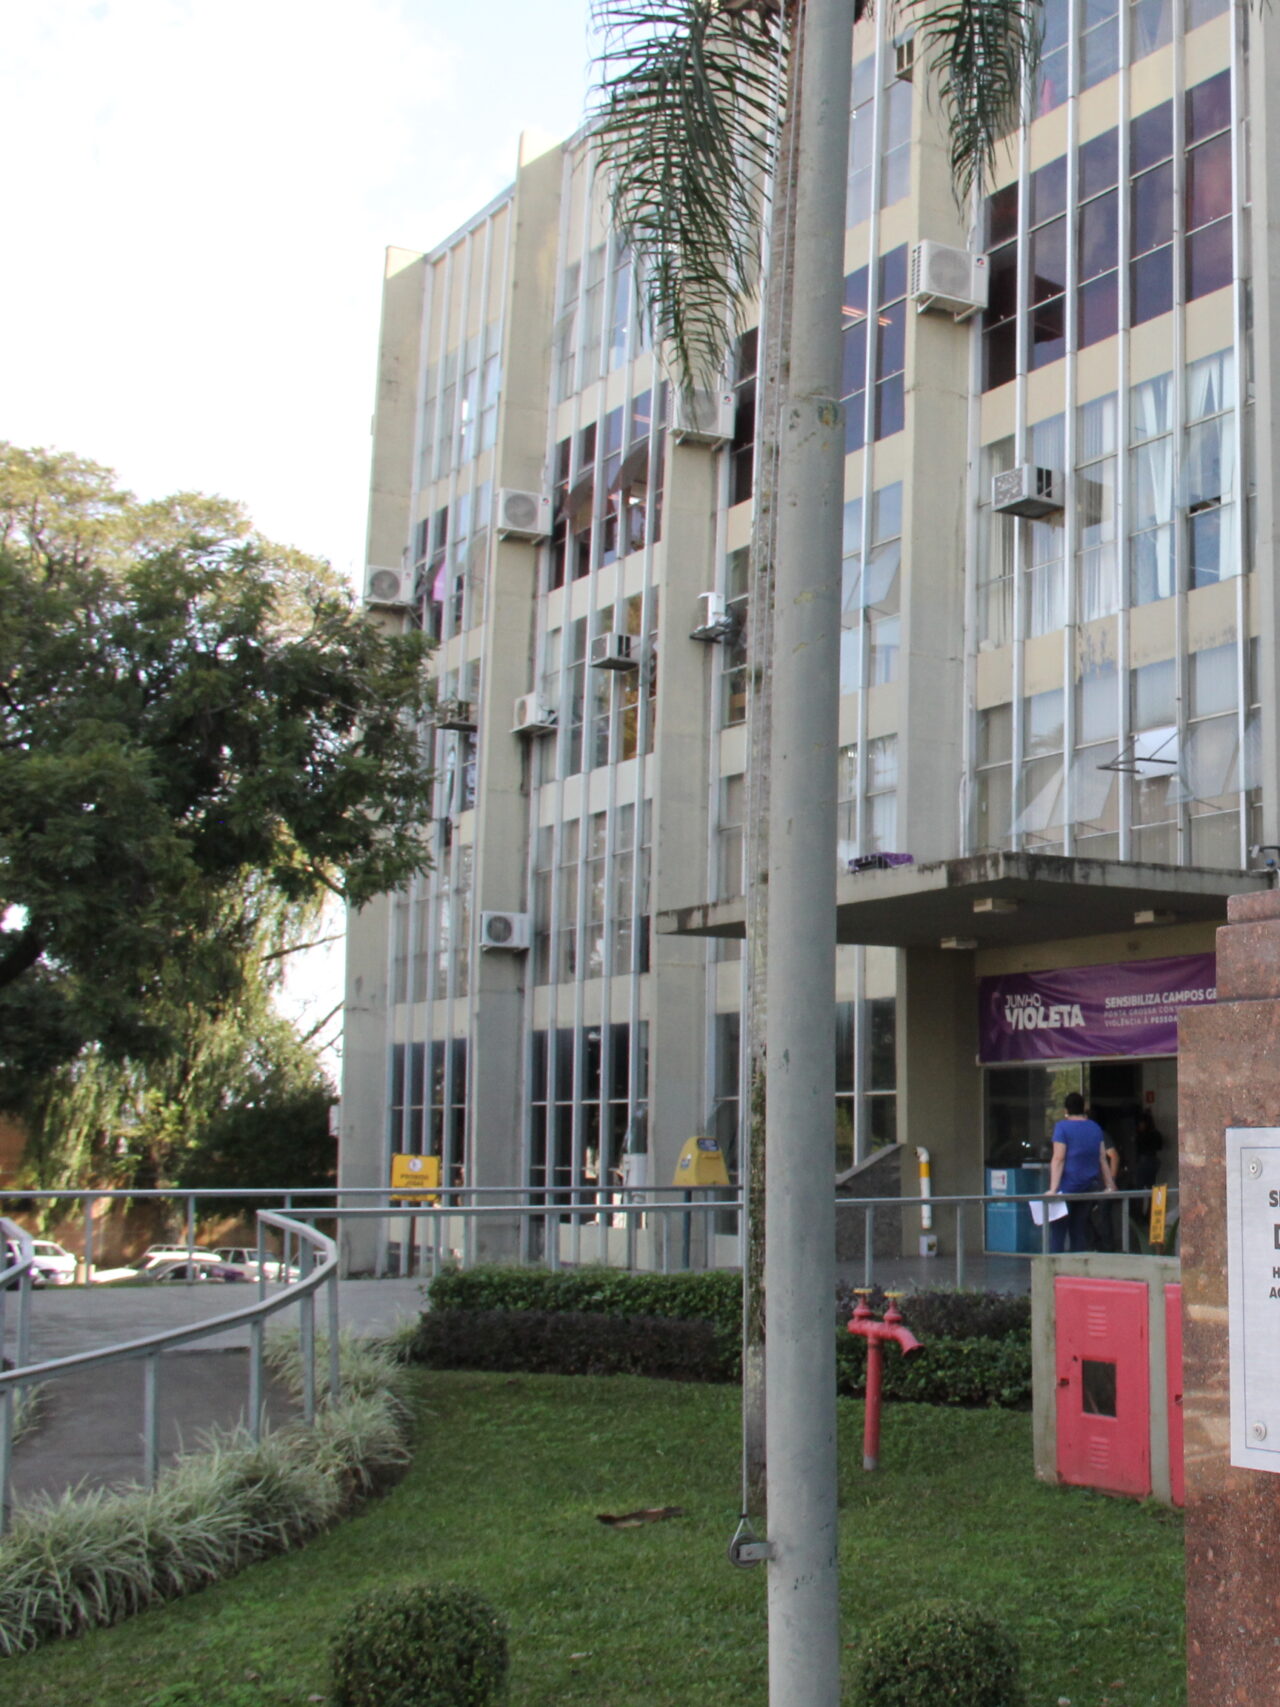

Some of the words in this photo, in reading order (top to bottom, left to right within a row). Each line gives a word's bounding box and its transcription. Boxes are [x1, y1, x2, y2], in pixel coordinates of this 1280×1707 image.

[1004, 993, 1041, 1008] JUNHO
[1105, 993, 1161, 1008] SENSIBILIZA
[1162, 989, 1204, 1003] CAMPOS
[1205, 988, 1217, 999] GE
[1005, 1004, 1086, 1030] VIOLETA
[1158, 1006, 1178, 1014] CONT
